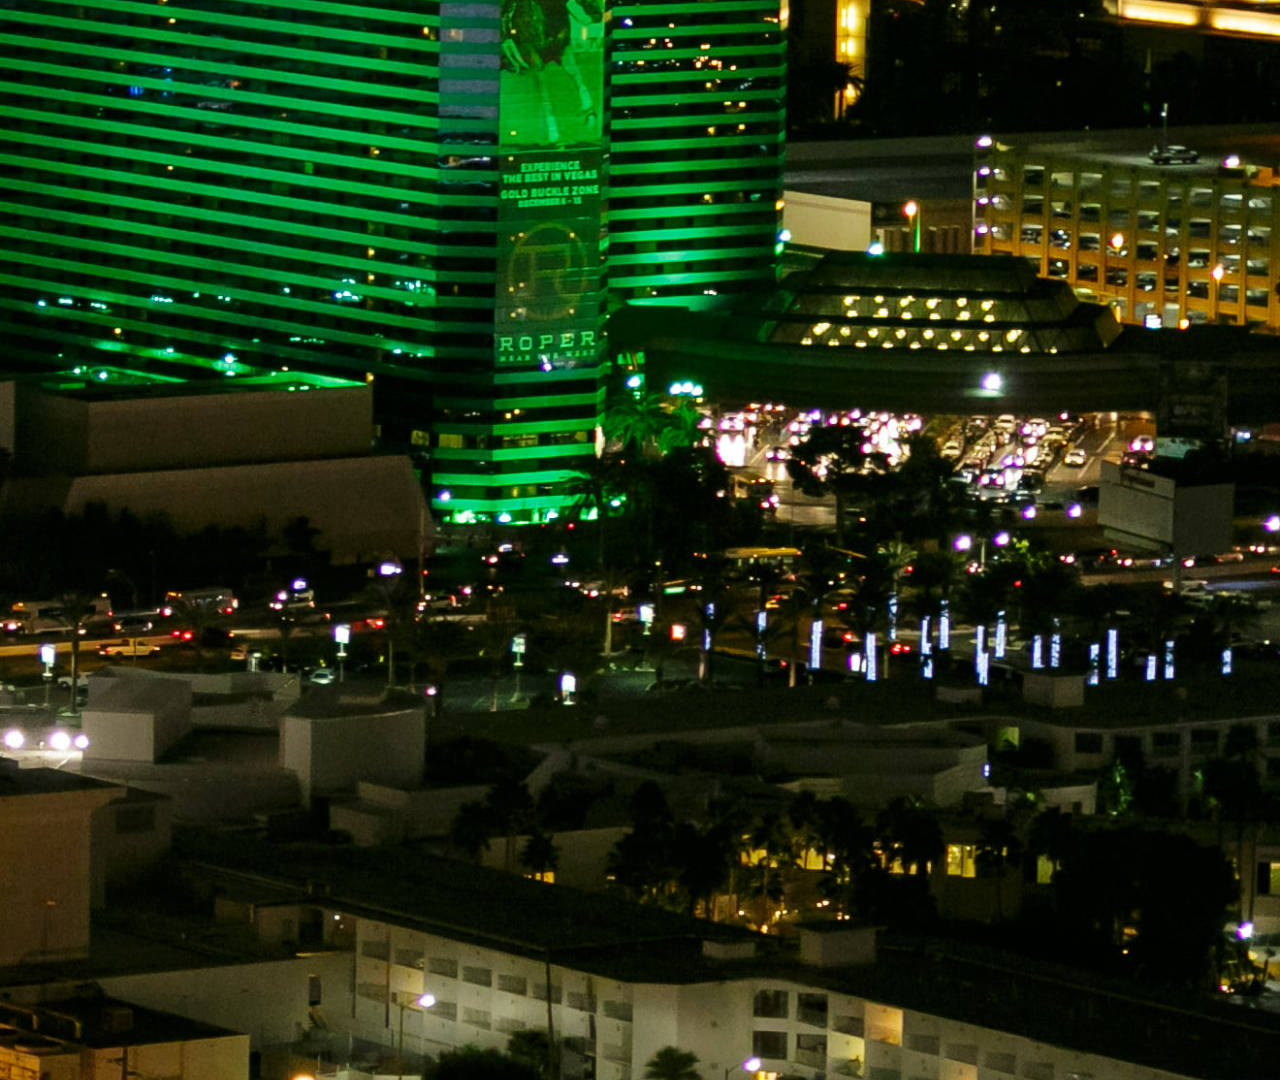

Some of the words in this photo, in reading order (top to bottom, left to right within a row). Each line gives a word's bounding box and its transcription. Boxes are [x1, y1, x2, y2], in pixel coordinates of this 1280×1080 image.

[501, 189, 529, 199] GOLD
[572, 185, 599, 195] ZONE
[499, 331, 596, 352] ROPER
